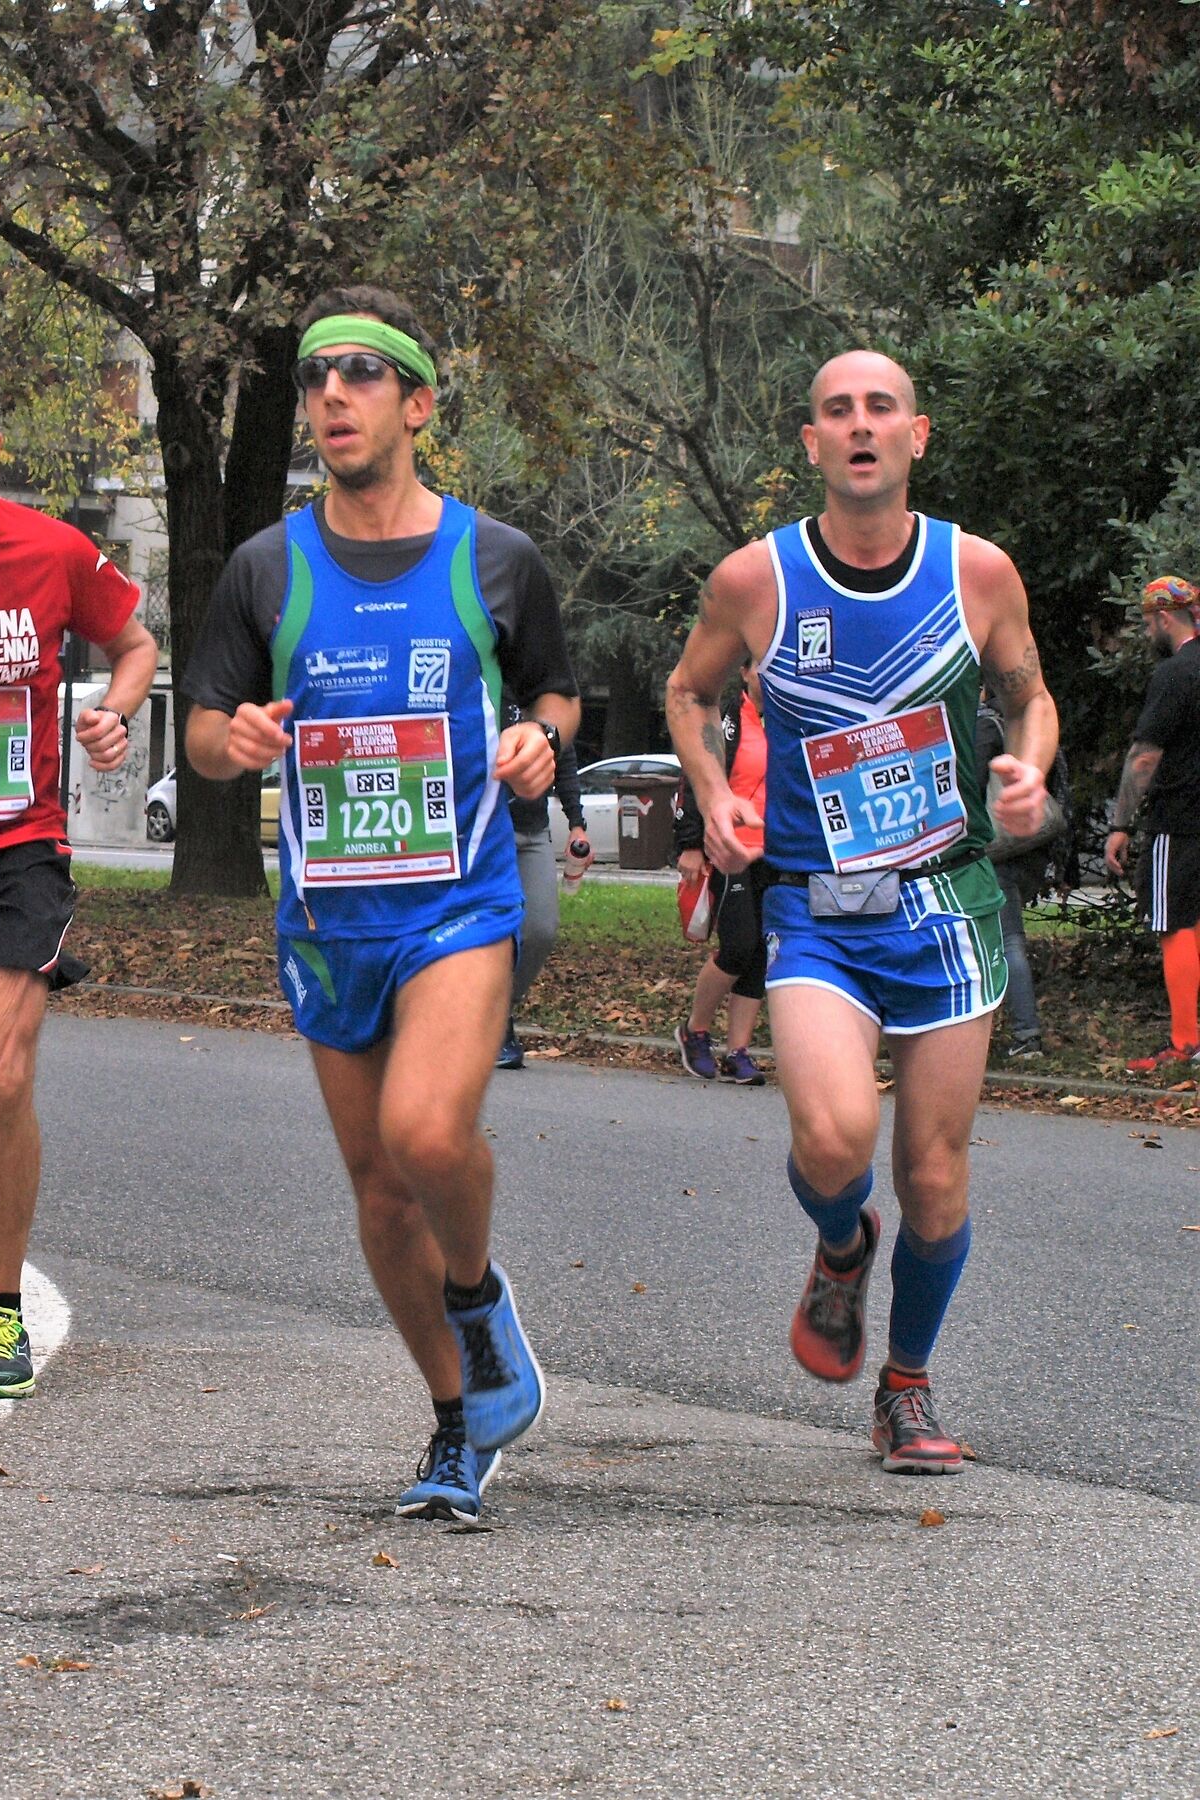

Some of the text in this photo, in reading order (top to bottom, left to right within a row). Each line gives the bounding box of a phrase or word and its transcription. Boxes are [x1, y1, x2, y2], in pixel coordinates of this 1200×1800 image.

[410, 639, 451, 648] PODISTICA
[798, 657, 832, 670] seven
[308, 674, 388, 688] AUTOTRASPORTI
[337, 724, 395, 738] XX MARATONA
[844, 721, 899, 745] XX MARATONA
[871, 729, 904, 747] RAVENNA
[363, 733, 397, 746] RAVENNA
[858, 785, 930, 833] 1222
[339, 799, 413, 838] 1220
[875, 828, 915, 847] MATTEO
[344, 842, 388, 854] ANDREA
